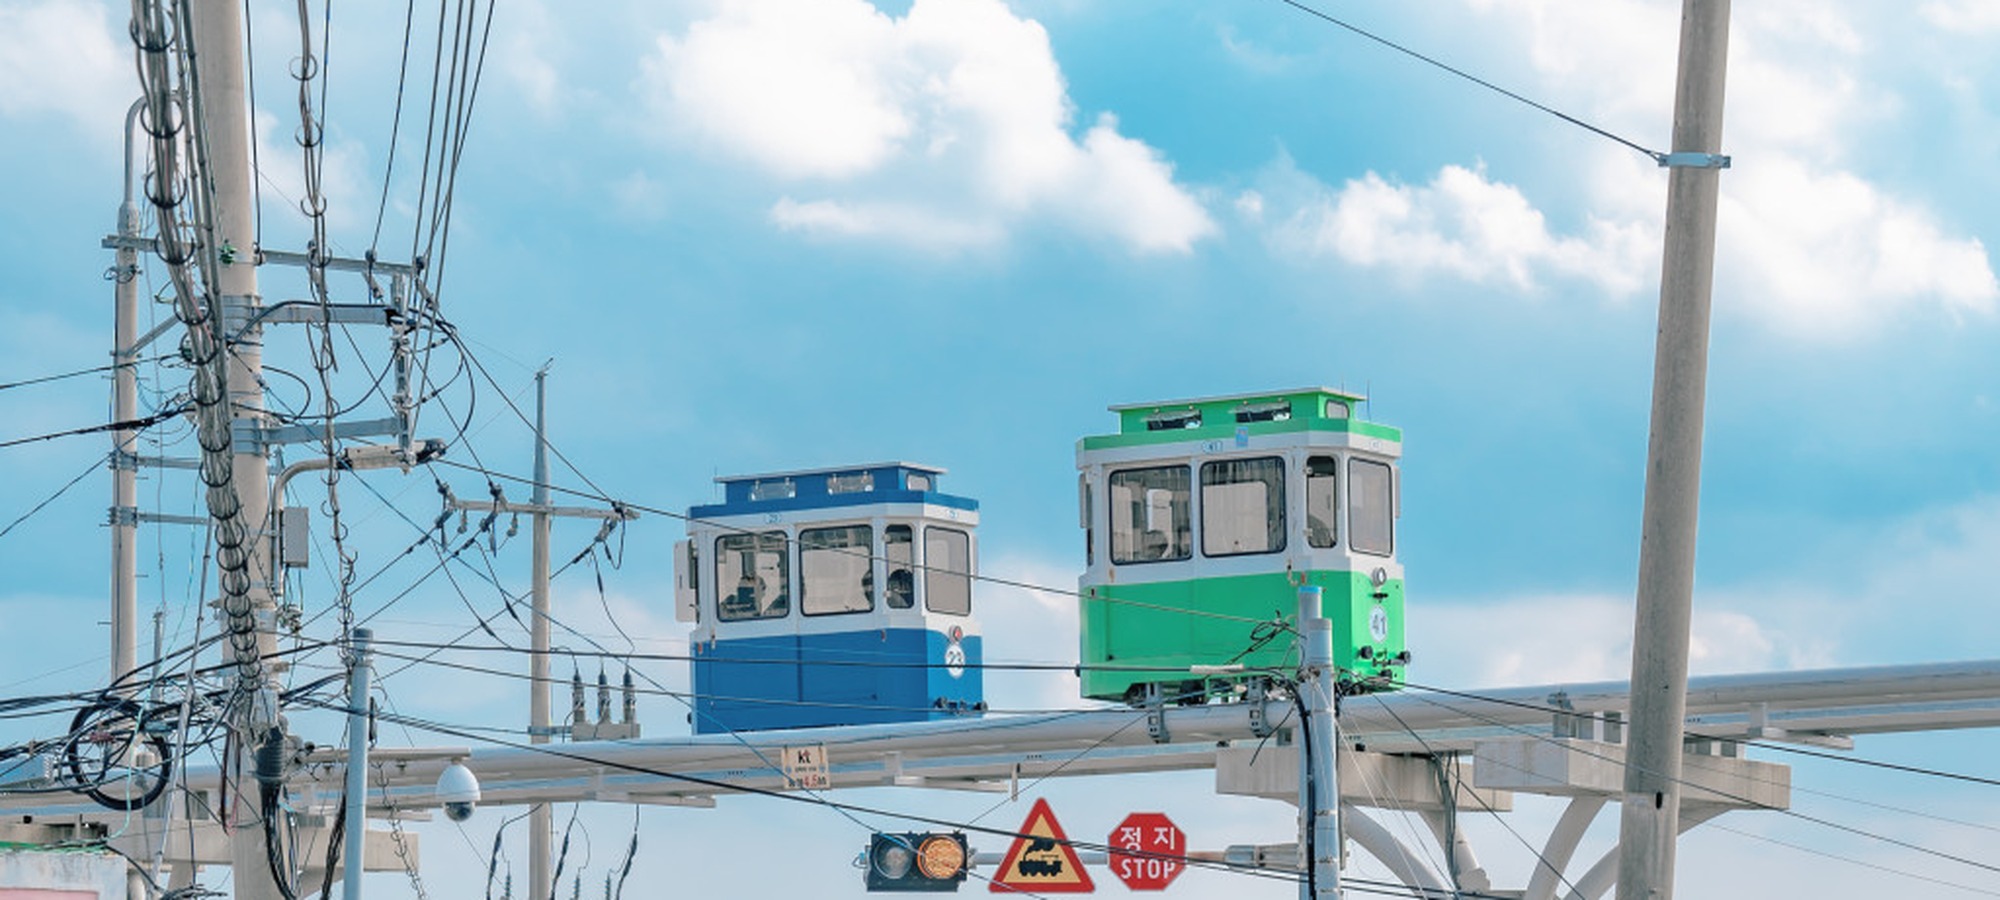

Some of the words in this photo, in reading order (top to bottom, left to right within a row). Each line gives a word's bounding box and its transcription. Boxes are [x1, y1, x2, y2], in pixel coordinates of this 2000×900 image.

[1372, 614, 1386, 635] 41
[947, 650, 964, 668] 23
[1121, 858, 1176, 879] STOP
